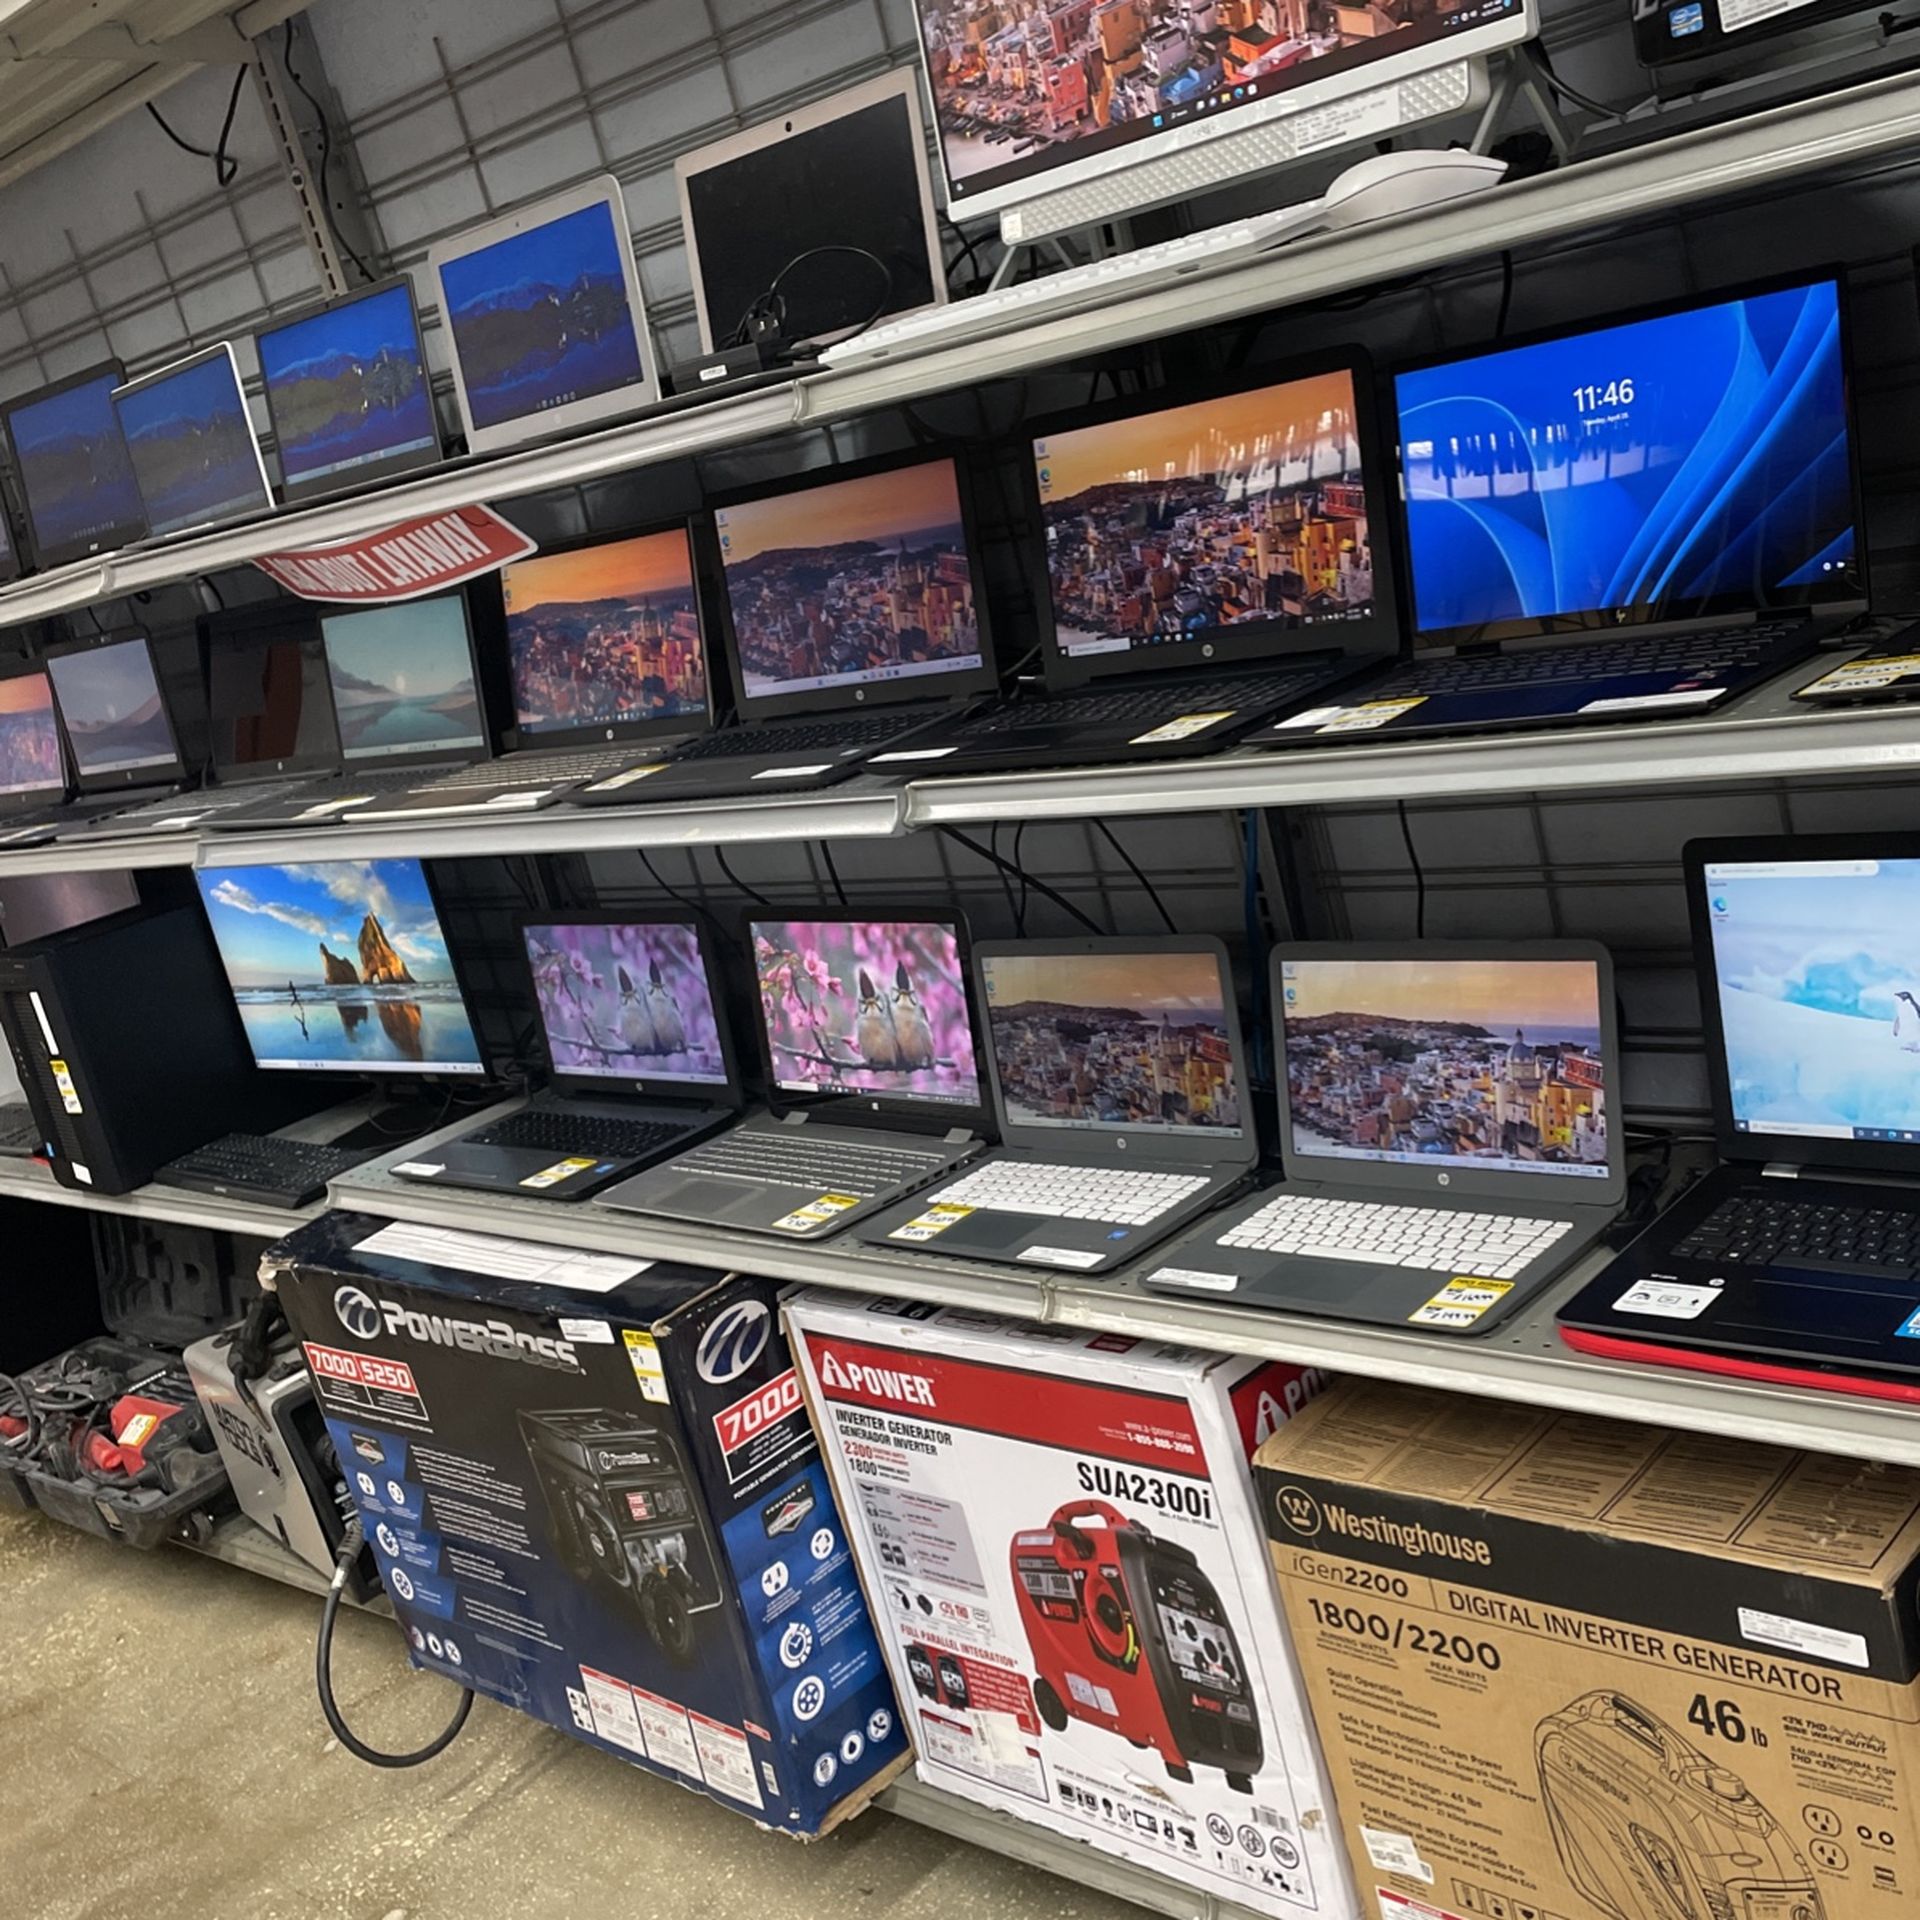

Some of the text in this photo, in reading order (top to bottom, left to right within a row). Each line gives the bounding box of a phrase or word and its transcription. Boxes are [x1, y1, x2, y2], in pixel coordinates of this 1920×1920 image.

[1573, 378, 1634, 412] 11:46
[298, 554, 388, 592] ABOUT
[356, 511, 492, 587] LAYAWAY
[314, 1351, 410, 1389] 7000 5250
[723, 1376, 800, 1443] 7000
[835, 1409, 953, 1446] INVERTER GENERATOR
[839, 1424, 938, 1456] GENERADOR INVERTER
[843, 1440, 873, 1460] 2300
[849, 1458, 877, 1476] 1800
[1077, 1461, 1212, 1519] SUA2300i
[1323, 1503, 1492, 1566] Westinghouse
[1292, 1553, 1408, 1598] iGen2200
[1308, 1598, 1501, 1671] 1800/2200
[1360, 1639, 1389, 1655] WATTS
[1448, 1589, 1843, 1701] DIGITAL INVERTER GENERATOR
[1327, 1667, 1353, 1683] Quiet
[1355, 1675, 1404, 1698] Operation
[1430, 1660, 1454, 1673] PEAK
[1456, 1668, 1488, 1683] WATTS
[1687, 1693, 1768, 1748] 46 lb
[1805, 1720, 1828, 1732] THD
[1338, 1712, 1359, 1726] Safe
[1361, 1719, 1375, 1732] for
[1377, 1724, 1430, 1750] Electronics
[1440, 1744, 1468, 1761] Clean
[1471, 1755, 1503, 1771] Power
[1810, 1731, 1842, 1743] WAVE
[1844, 1739, 1888, 1754] OUTPUT
[1349, 1757, 1405, 1782] Lightweight
[1408, 1776, 1442, 1795] Design
[1875, 1766, 1896, 1776] CON
[1482, 1779, 1508, 1795] Clean
[1510, 1788, 1537, 1802] Power
[1360, 1801, 1380, 1815] Fuel
[1382, 1809, 1423, 1831] Efficient
[1425, 1825, 1447, 1840] with
[1448, 1834, 1468, 1847] Eco
[1470, 1841, 1499, 1857] Mode
